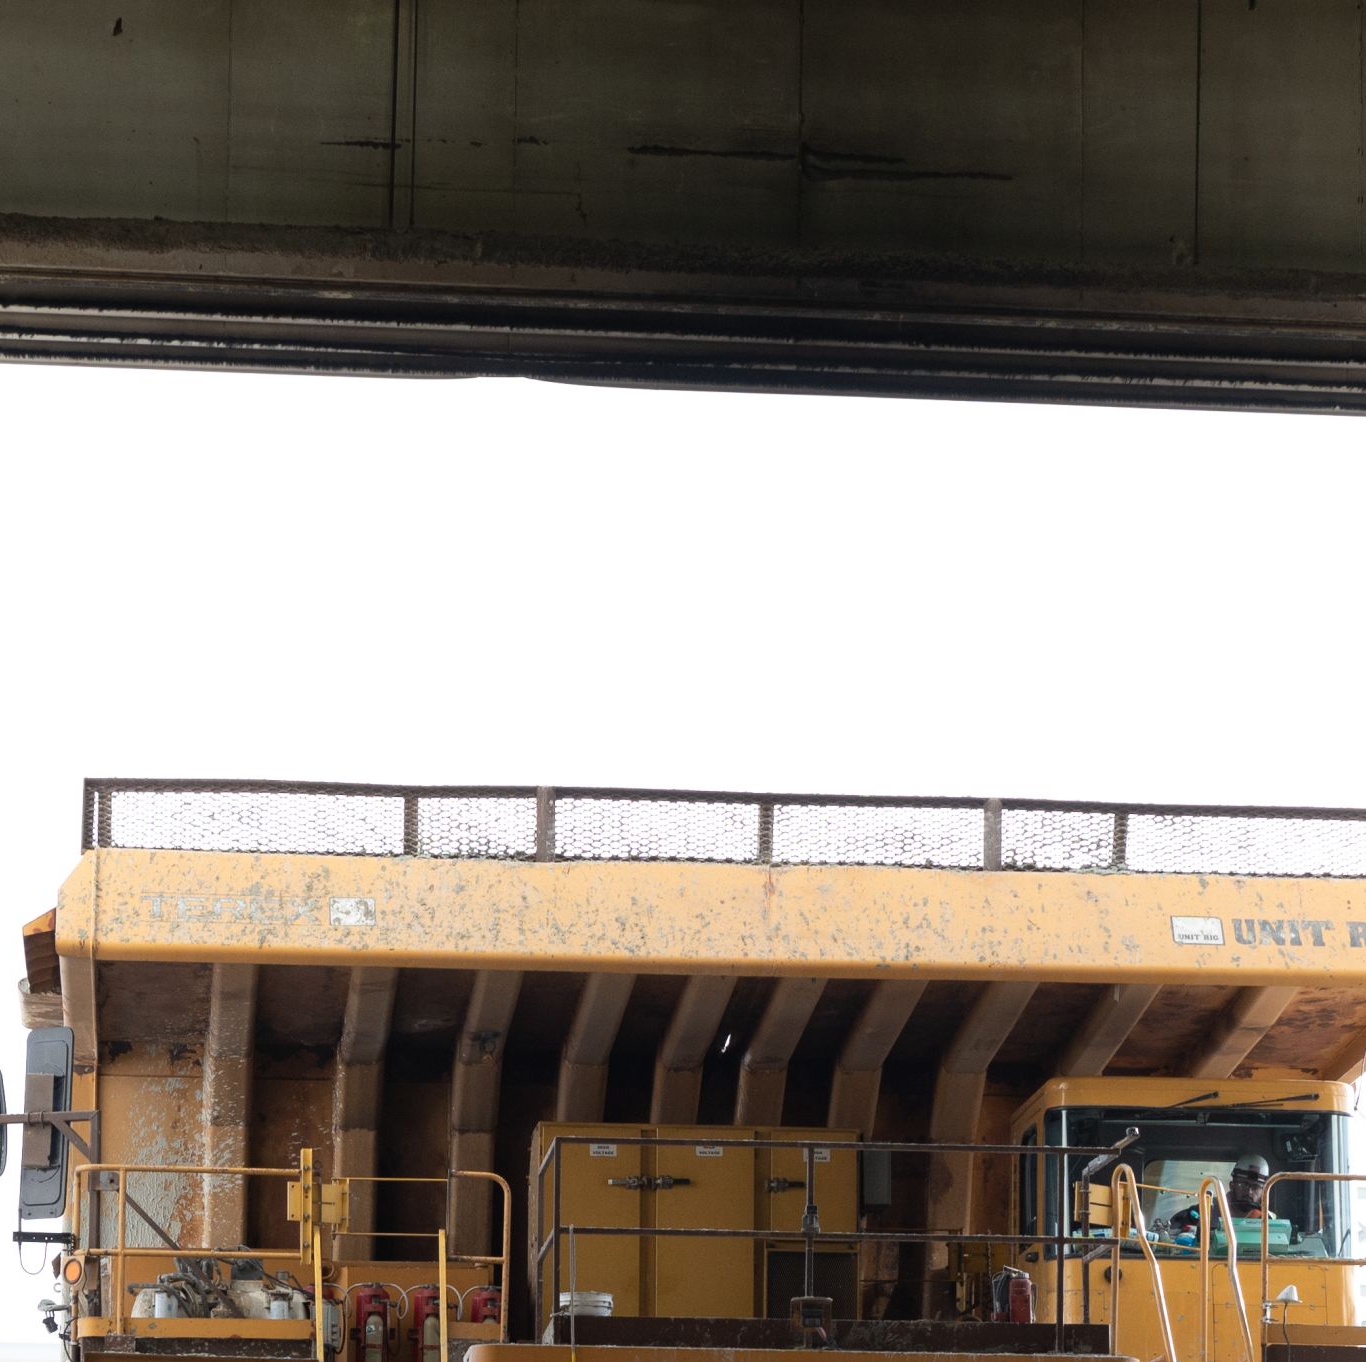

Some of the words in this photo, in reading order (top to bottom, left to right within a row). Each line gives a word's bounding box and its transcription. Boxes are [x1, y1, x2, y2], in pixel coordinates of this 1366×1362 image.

[140, 894, 326, 924] TEREX
[1177, 933, 1200, 941] UNIT
[1231, 918, 1335, 947] UNIT
